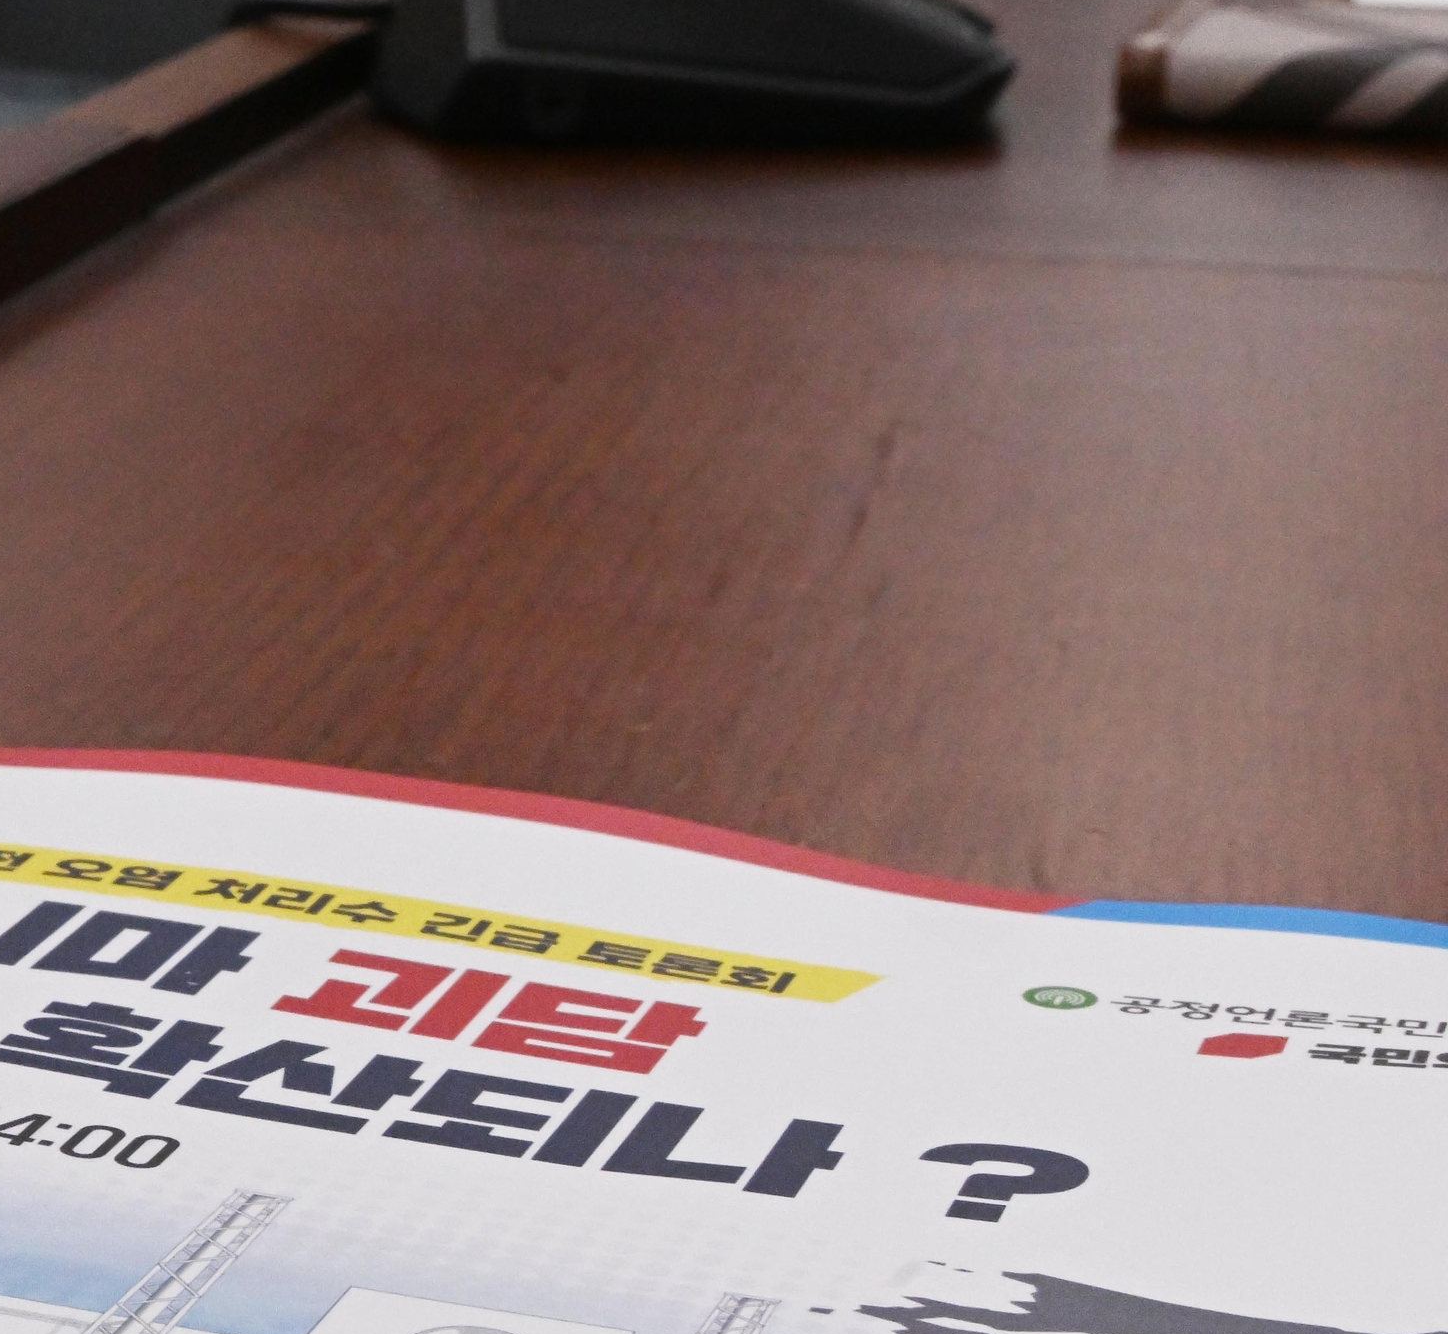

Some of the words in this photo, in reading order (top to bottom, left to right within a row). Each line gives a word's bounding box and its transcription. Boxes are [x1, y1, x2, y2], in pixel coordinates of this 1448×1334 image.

[44, 857, 182, 894] 오염
[195, 878, 397, 927] 처리수
[418, 912, 559, 952] 긴급
[577, 942, 798, 995] 토론회
[271, 948, 707, 1075] 괴담
[917, 1141, 1090, 1224] ?
